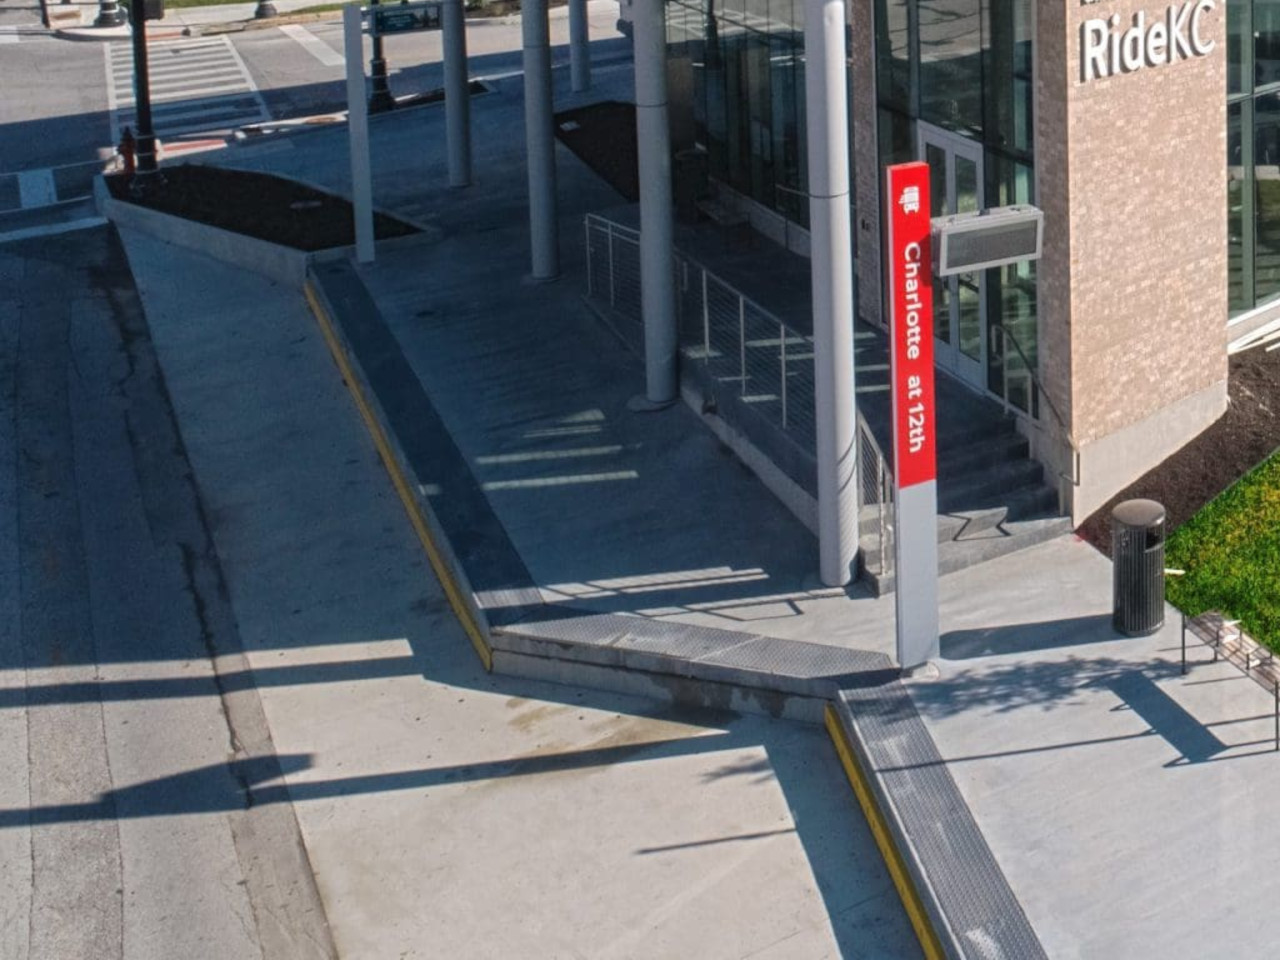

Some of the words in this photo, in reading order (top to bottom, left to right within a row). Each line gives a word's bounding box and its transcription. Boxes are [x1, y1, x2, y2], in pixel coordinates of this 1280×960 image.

[904, 241, 923, 360] Charlotte
[908, 375, 923, 400] at
[908, 402, 926, 454] 12th
